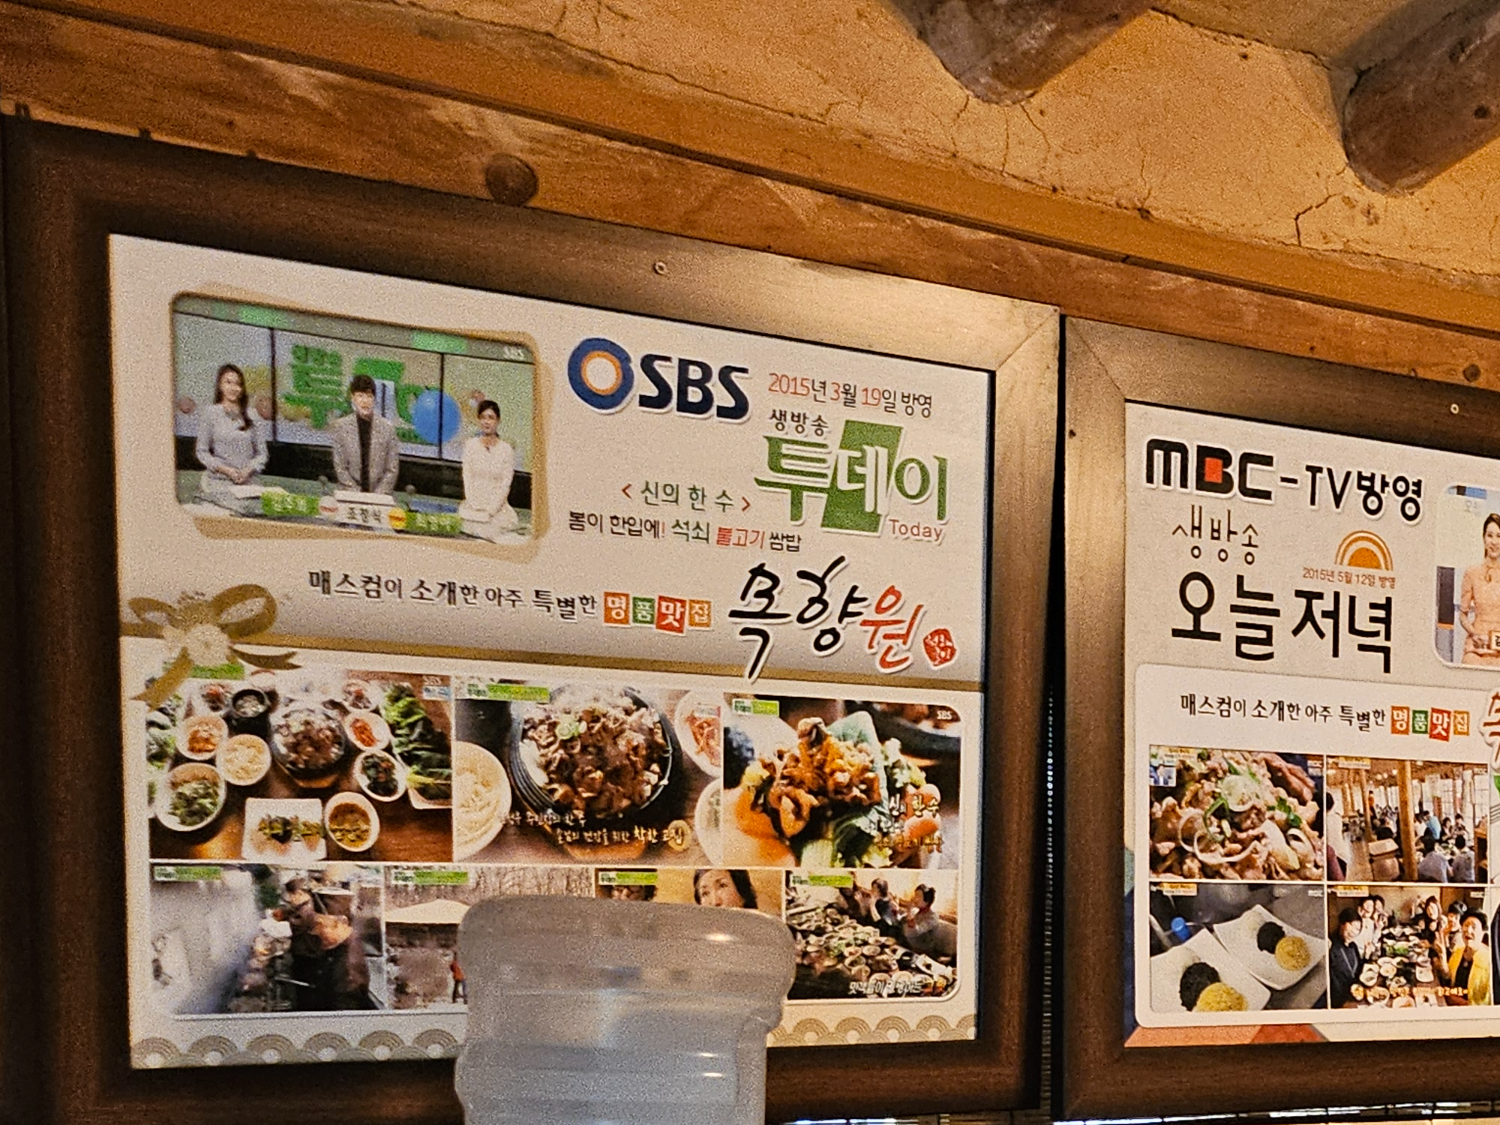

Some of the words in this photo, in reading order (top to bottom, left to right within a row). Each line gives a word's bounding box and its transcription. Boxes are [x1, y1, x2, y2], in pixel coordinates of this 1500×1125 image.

[639, 354, 749, 420] SBS
[768, 373, 829, 402] 2015년
[830, 382, 858, 407] 3월
[862, 387, 897, 413] 19일
[901, 391, 932, 418] 방영
[769, 409, 829, 437] 생방송
[640, 480, 679, 505] 신의
[688, 484, 706, 511] 한
[714, 489, 734, 512] 수
[754, 434, 949, 525] 투데이
[671, 518, 711, 544] 석쇠
[716, 526, 765, 550] 불고기
[769, 530, 802, 553] 쌈밥
[888, 518, 943, 543] Today
[1172, 505, 1260, 565] 생방송
[1303, 567, 1334, 582] 2015년
[308, 570, 403, 599] 매스컴이
[410, 579, 479, 606] 소개한
[485, 587, 523, 608] 아주
[532, 589, 597, 620] 특별한
[604, 592, 712, 634] 명품맛집
[728, 556, 924, 678] 목향원
[1181, 694, 1247, 719] 매스컴이
[1252, 700, 1301, 722] 소개한
[1305, 703, 1333, 721] 아주
[1339, 705, 1386, 732] 특별한
[1391, 705, 1470, 742] 명품맛집
